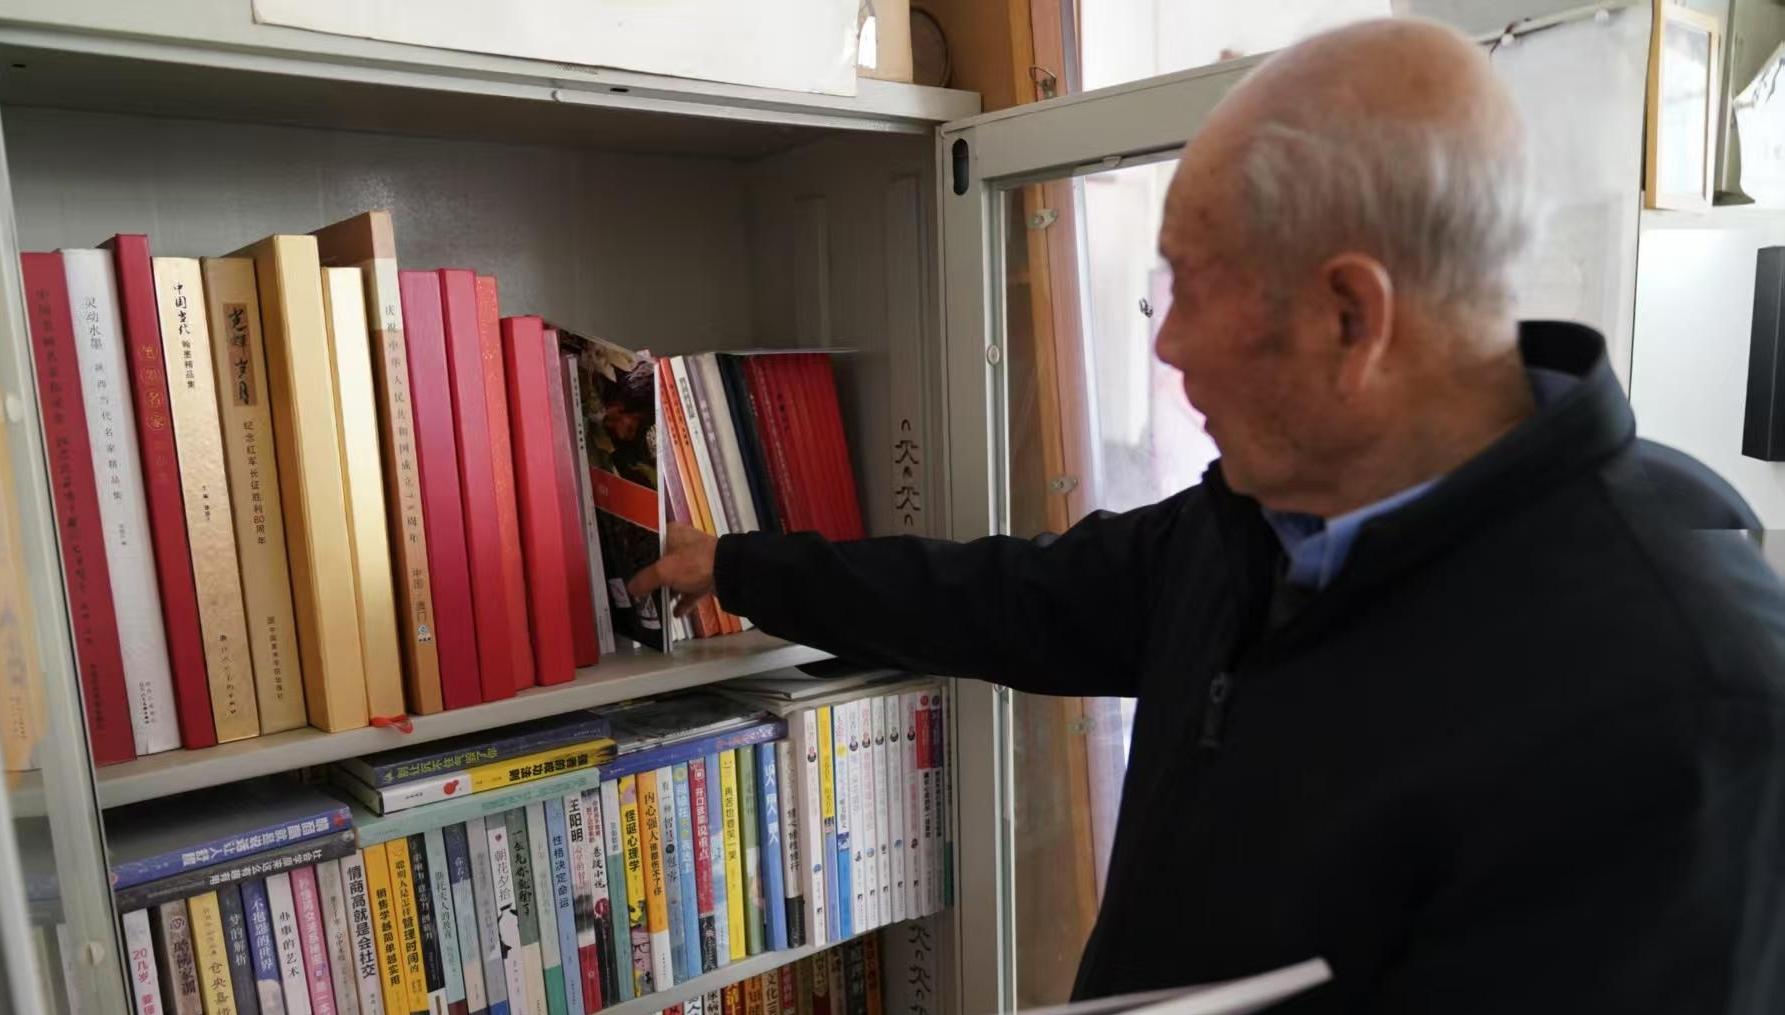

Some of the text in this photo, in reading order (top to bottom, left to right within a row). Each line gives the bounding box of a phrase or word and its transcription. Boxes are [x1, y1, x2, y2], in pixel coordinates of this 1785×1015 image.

[83, 297, 103, 350] 灵动水墨
[568, 799, 583, 843] 王阳明
[625, 809, 644, 872] 怪诞心理学
[494, 849, 511, 900] 朝花夕拾
[552, 836, 570, 909] 性格决定命运
[230, 912, 247, 966] 梦的解析
[252, 899, 273, 972] 不抱怨的世界
[279, 911, 300, 977] 办事的艺术
[347, 864, 376, 978] 情商高就是会社交
[376, 888, 401, 986] 销售学越简单越实用
